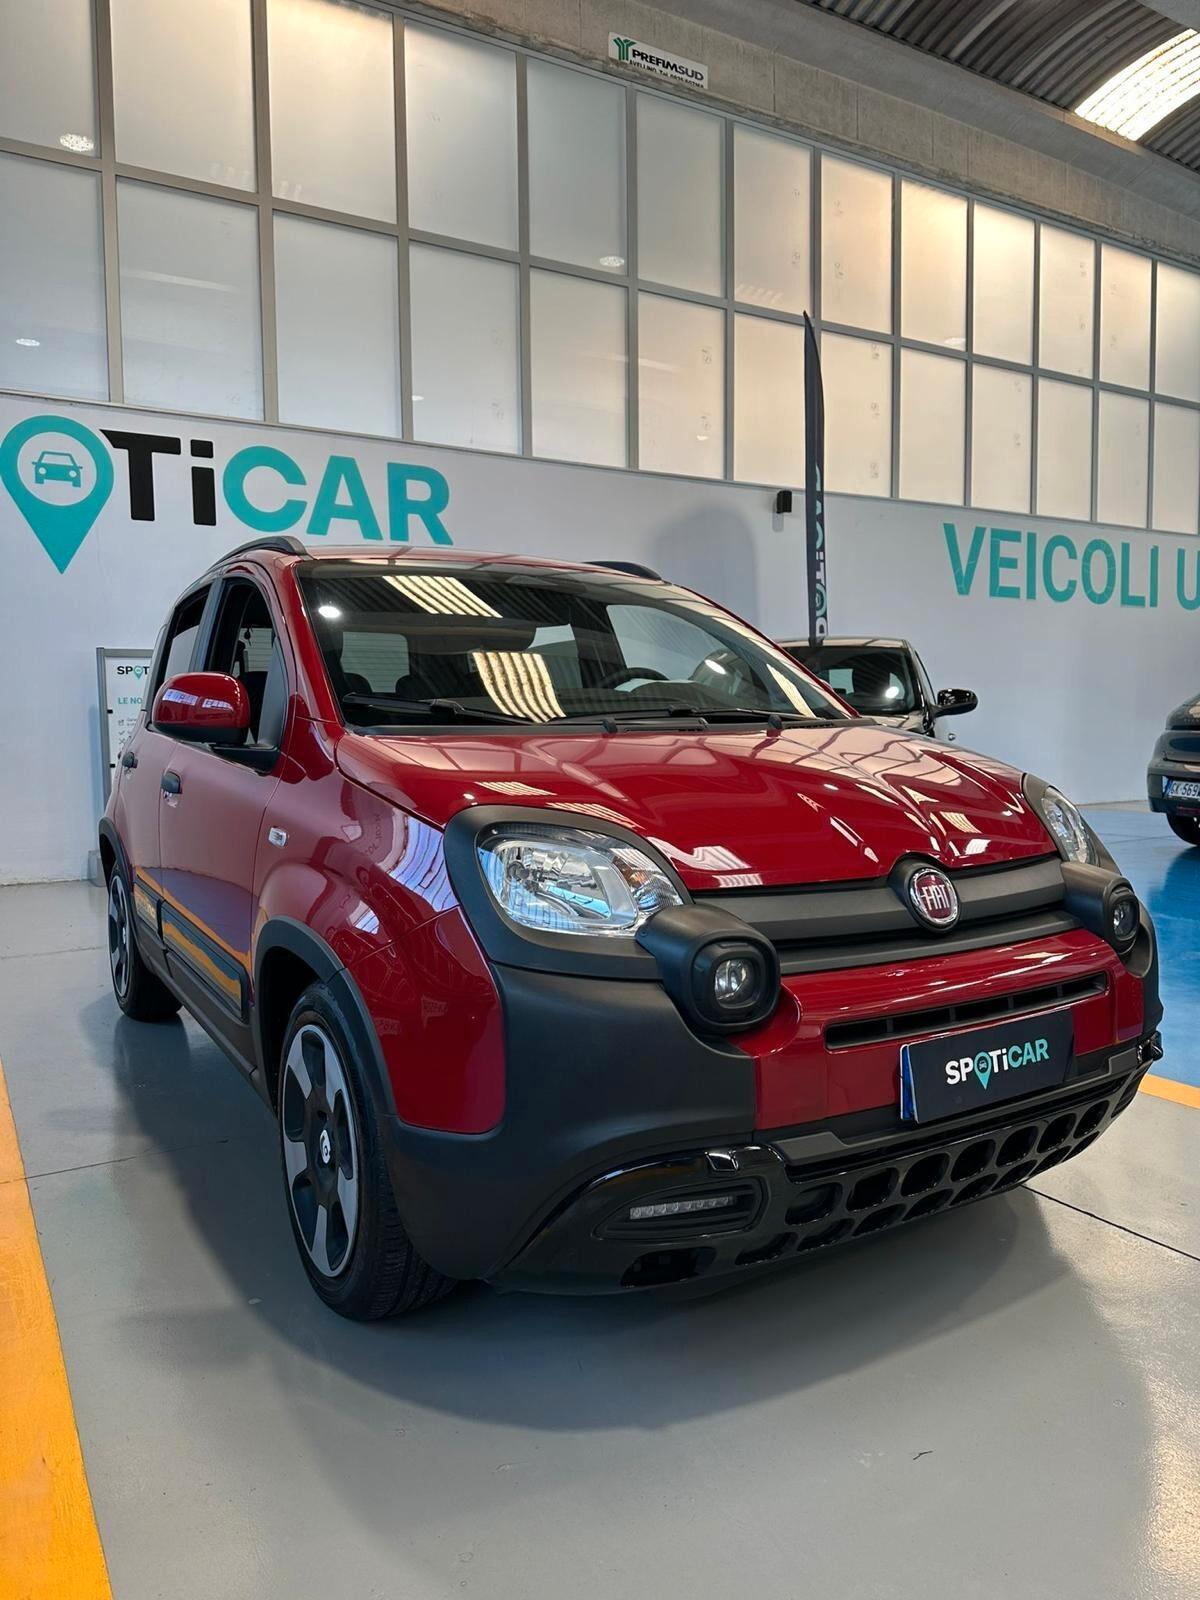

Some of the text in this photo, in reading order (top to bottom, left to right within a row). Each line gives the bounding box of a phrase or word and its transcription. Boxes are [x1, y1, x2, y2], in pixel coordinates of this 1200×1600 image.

[632, 48, 704, 81] PREFIMSUD
[943, 522, 1159, 608] VEICOLI
[118, 697, 128, 705] LE
[1181, 783, 1200, 797] 569
[921, 884, 950, 910] FIAT
